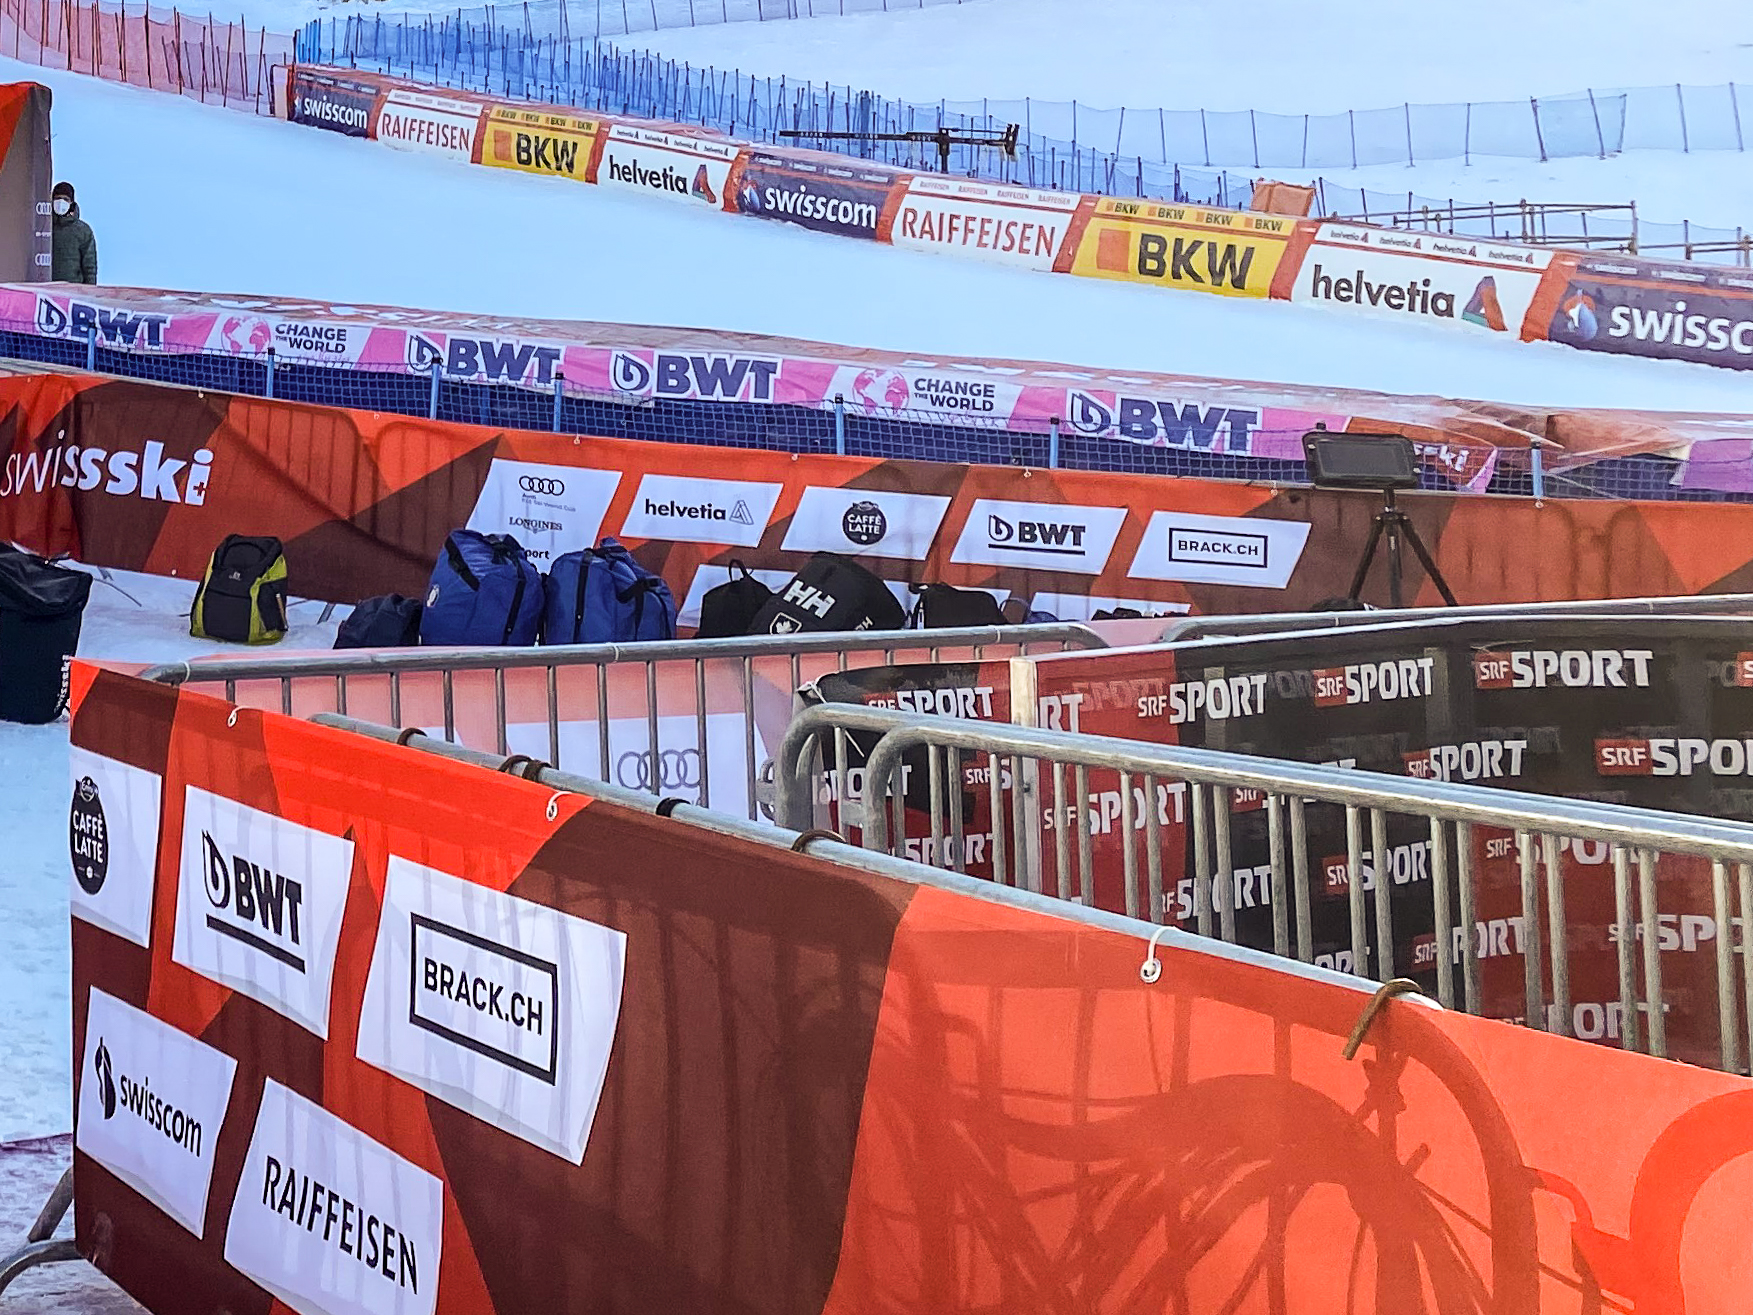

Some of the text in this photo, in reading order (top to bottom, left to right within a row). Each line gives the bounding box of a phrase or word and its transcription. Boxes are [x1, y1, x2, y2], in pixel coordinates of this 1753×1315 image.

[303, 94, 368, 129] swisscom
[382, 113, 470, 152] RAIFFEISEN
[516, 132, 578, 173] BKW
[609, 155, 689, 195] helvetia
[764, 185, 876, 229] swisscom
[1114, 202, 1282, 232] BKW BKW BKW BKW
[902, 207, 1055, 257] RAIFFEISEN
[1138, 233, 1255, 290] BKW
[1312, 264, 1456, 318] helvetia
[71, 302, 168, 346] BWT
[275, 324, 347, 341] CHANGE
[288, 338, 346, 353] WORLD
[449, 339, 561, 385] BWT
[655, 355, 777, 401] BWT
[914, 377, 996, 399] CHANGE
[930, 395, 994, 413] WORLD
[1120, 397, 1259, 453] BWT
[0, 429, 215, 506] swissski
[509, 516, 563, 531] LONGINES
[645, 498, 727, 521] helvetia
[848, 522, 881, 535] LATTE
[1018, 522, 1086, 547] BWT
[1177, 540, 1259, 557] BRACK.CH
[782, 580, 836, 619] HH
[1317, 657, 1435, 703] SRF SPORT
[1480, 649, 1653, 688] SRF SPORT
[897, 686, 994, 718] SPORT
[1138, 674, 1267, 724] SRF SPORT
[1408, 740, 1527, 782] SRF SPORT
[1602, 746, 1647, 766] SRF
[73, 809, 104, 840] CAFFÈ
[1043, 806, 1077, 830] SF
[74, 832, 104, 863] LATTE
[1486, 837, 1513, 859] SRF
[1326, 864, 1350, 885] SR
[233, 855, 302, 945] BWT
[424, 958, 543, 1036] BRACK.CH
[119, 1072, 202, 1158] swisscom
[262, 1155, 417, 1295] RAIFFEISEN
